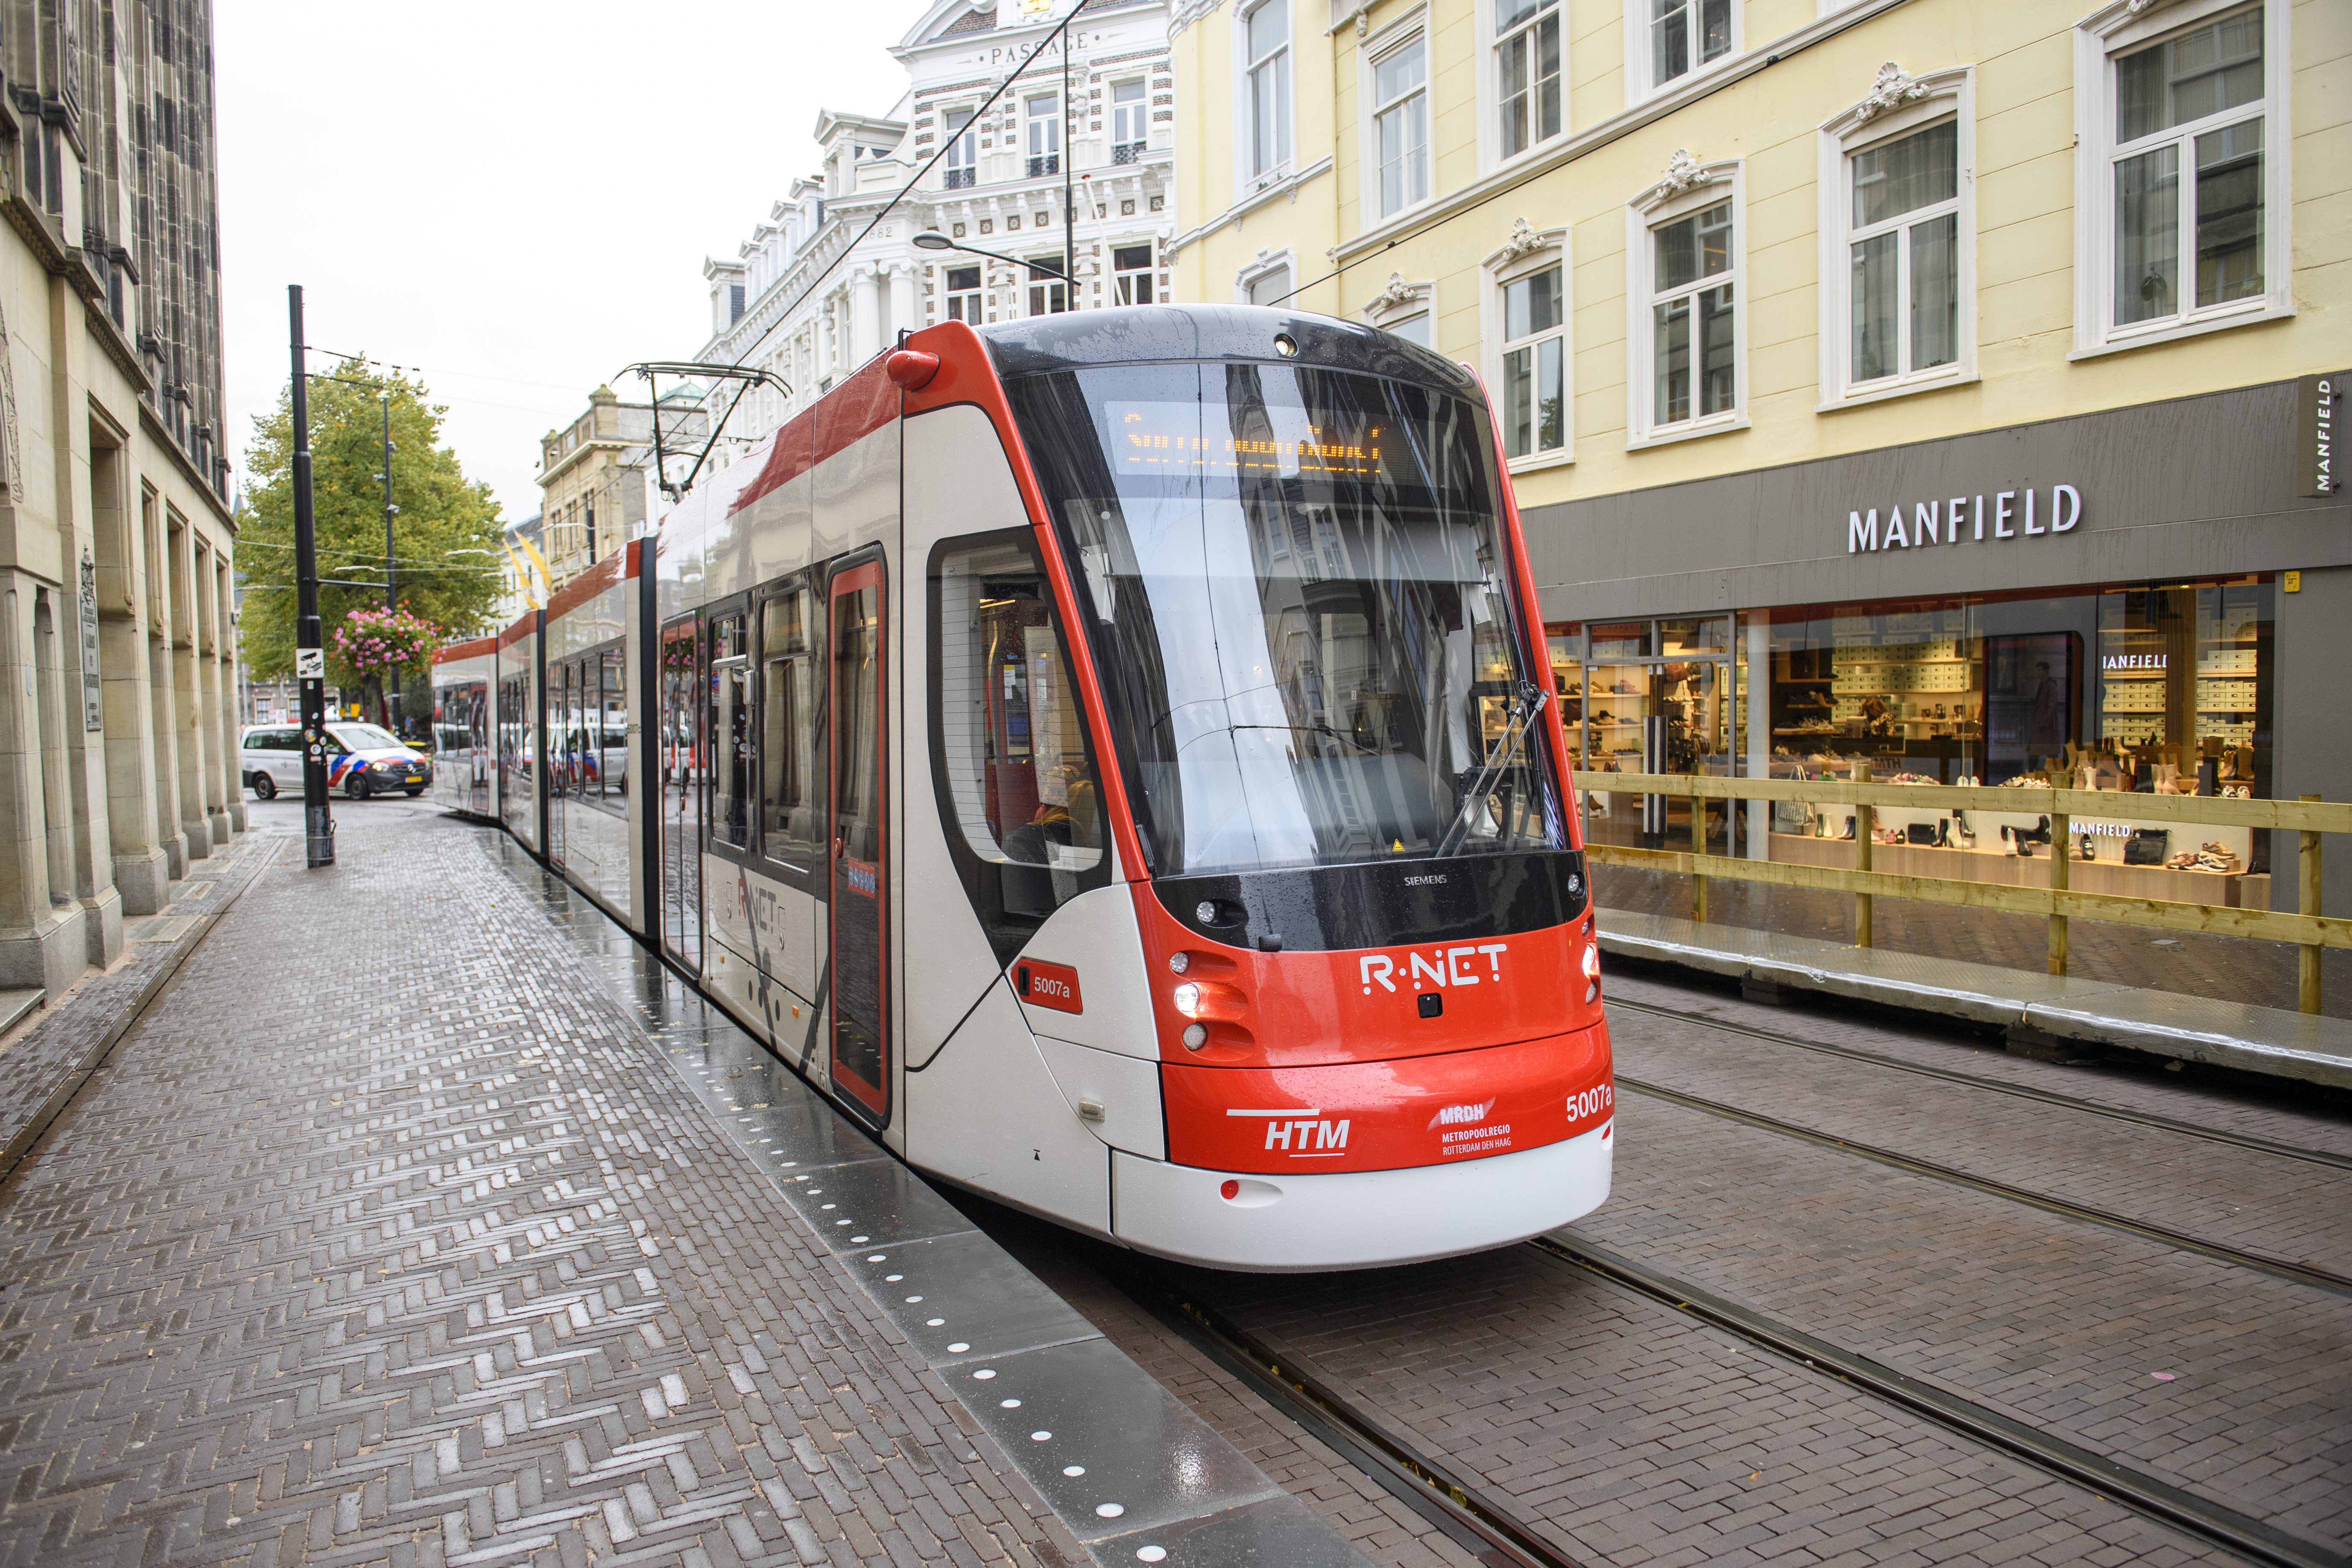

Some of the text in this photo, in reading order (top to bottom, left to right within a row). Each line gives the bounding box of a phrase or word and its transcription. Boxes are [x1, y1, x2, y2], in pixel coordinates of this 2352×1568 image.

[992, 32, 1088, 64] PASSAGE
[2317, 380, 2331, 491] MANFIELD
[1849, 484, 2082, 553] MANFIELD
[2069, 822, 2131, 837] MANFIELD
[1404, 874, 1447, 886] SIEMENS
[1034, 976, 1070, 998] 5007a
[1567, 1083, 1612, 1122] 5007a
[1440, 1103, 1484, 1125] MRDH
[1264, 1119, 1351, 1150] HTM
[1442, 1124, 1511, 1143] METROPOOLREGIO
[1443, 1137, 1511, 1156] ROTTERDAM DEN HAAG
